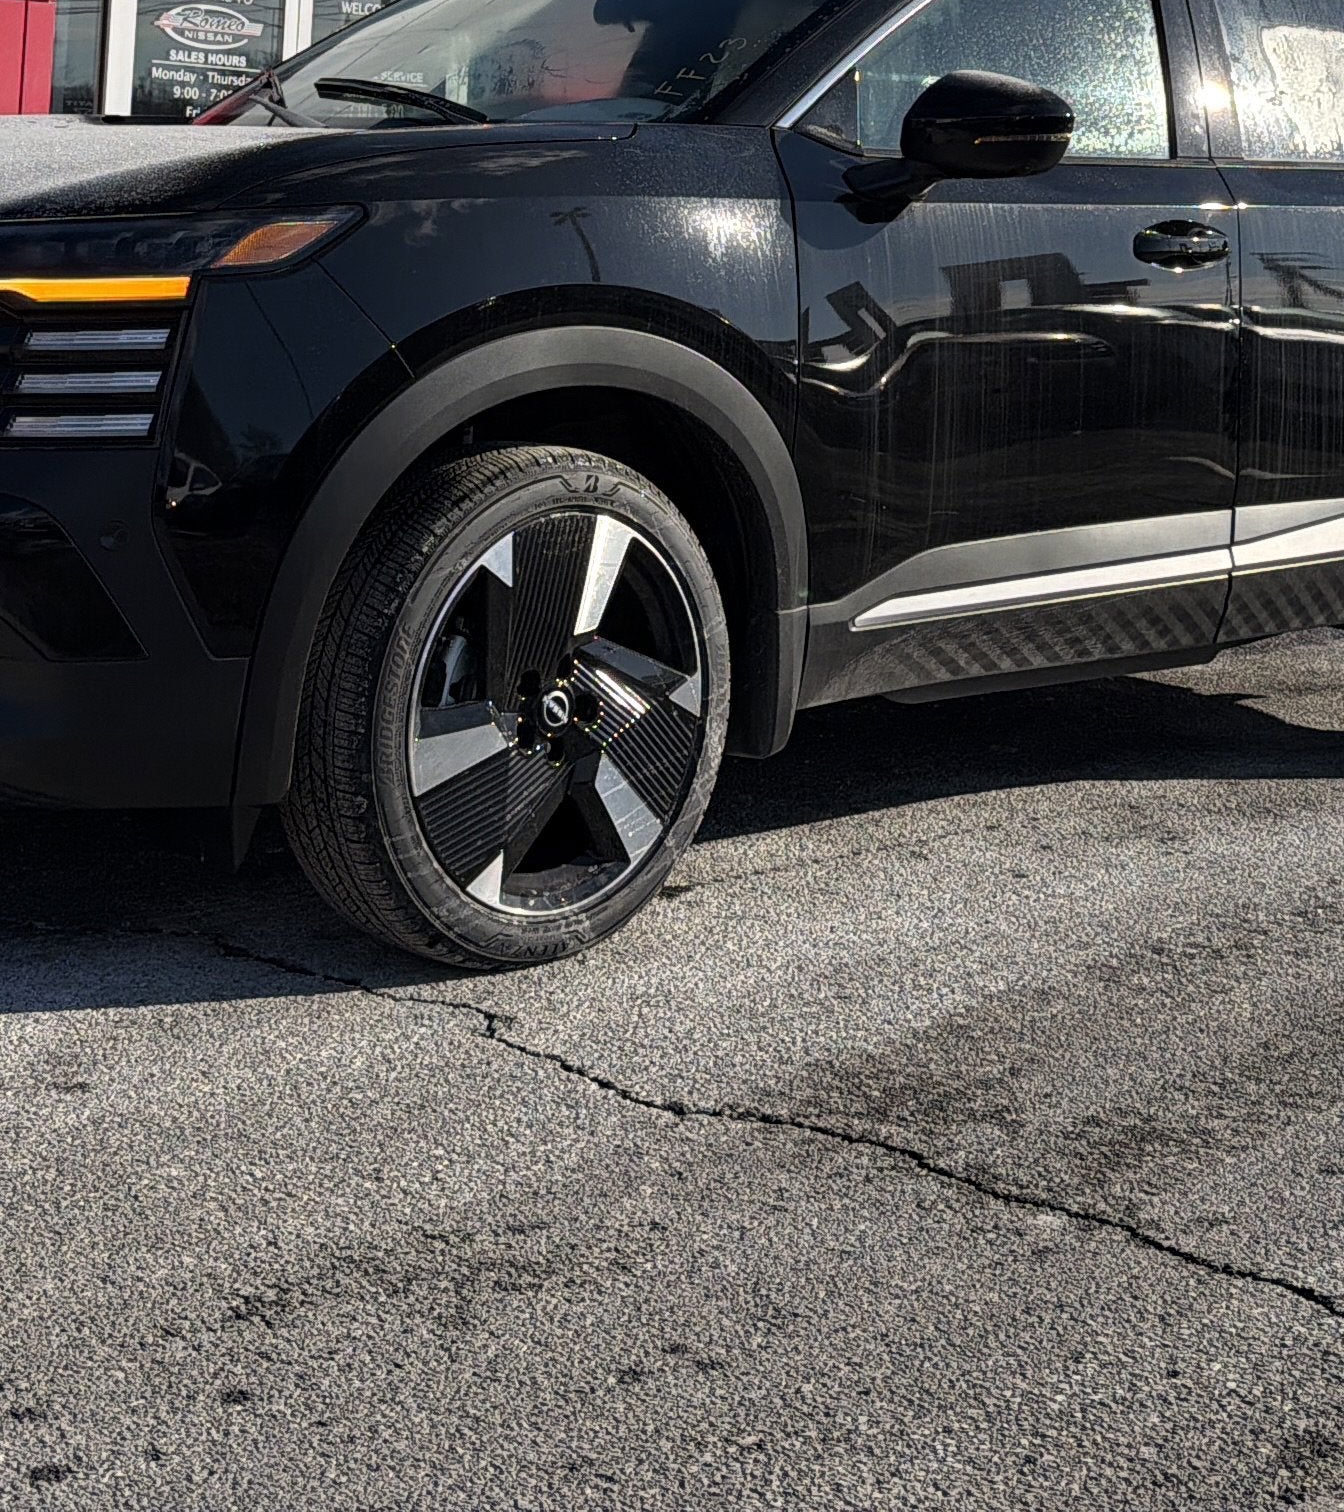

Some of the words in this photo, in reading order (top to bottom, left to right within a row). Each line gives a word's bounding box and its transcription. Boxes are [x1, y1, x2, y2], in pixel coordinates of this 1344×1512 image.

[175, 6, 245, 31] Romeo
[184, 29, 233, 43] NISSAN
[169, 49, 205, 64] SALES
[207, 53, 247, 67] HOURS
[151, 67, 197, 84] Monday
[381, 71, 423, 83] SERVICE
[173, 86, 199, 100] 9:00
